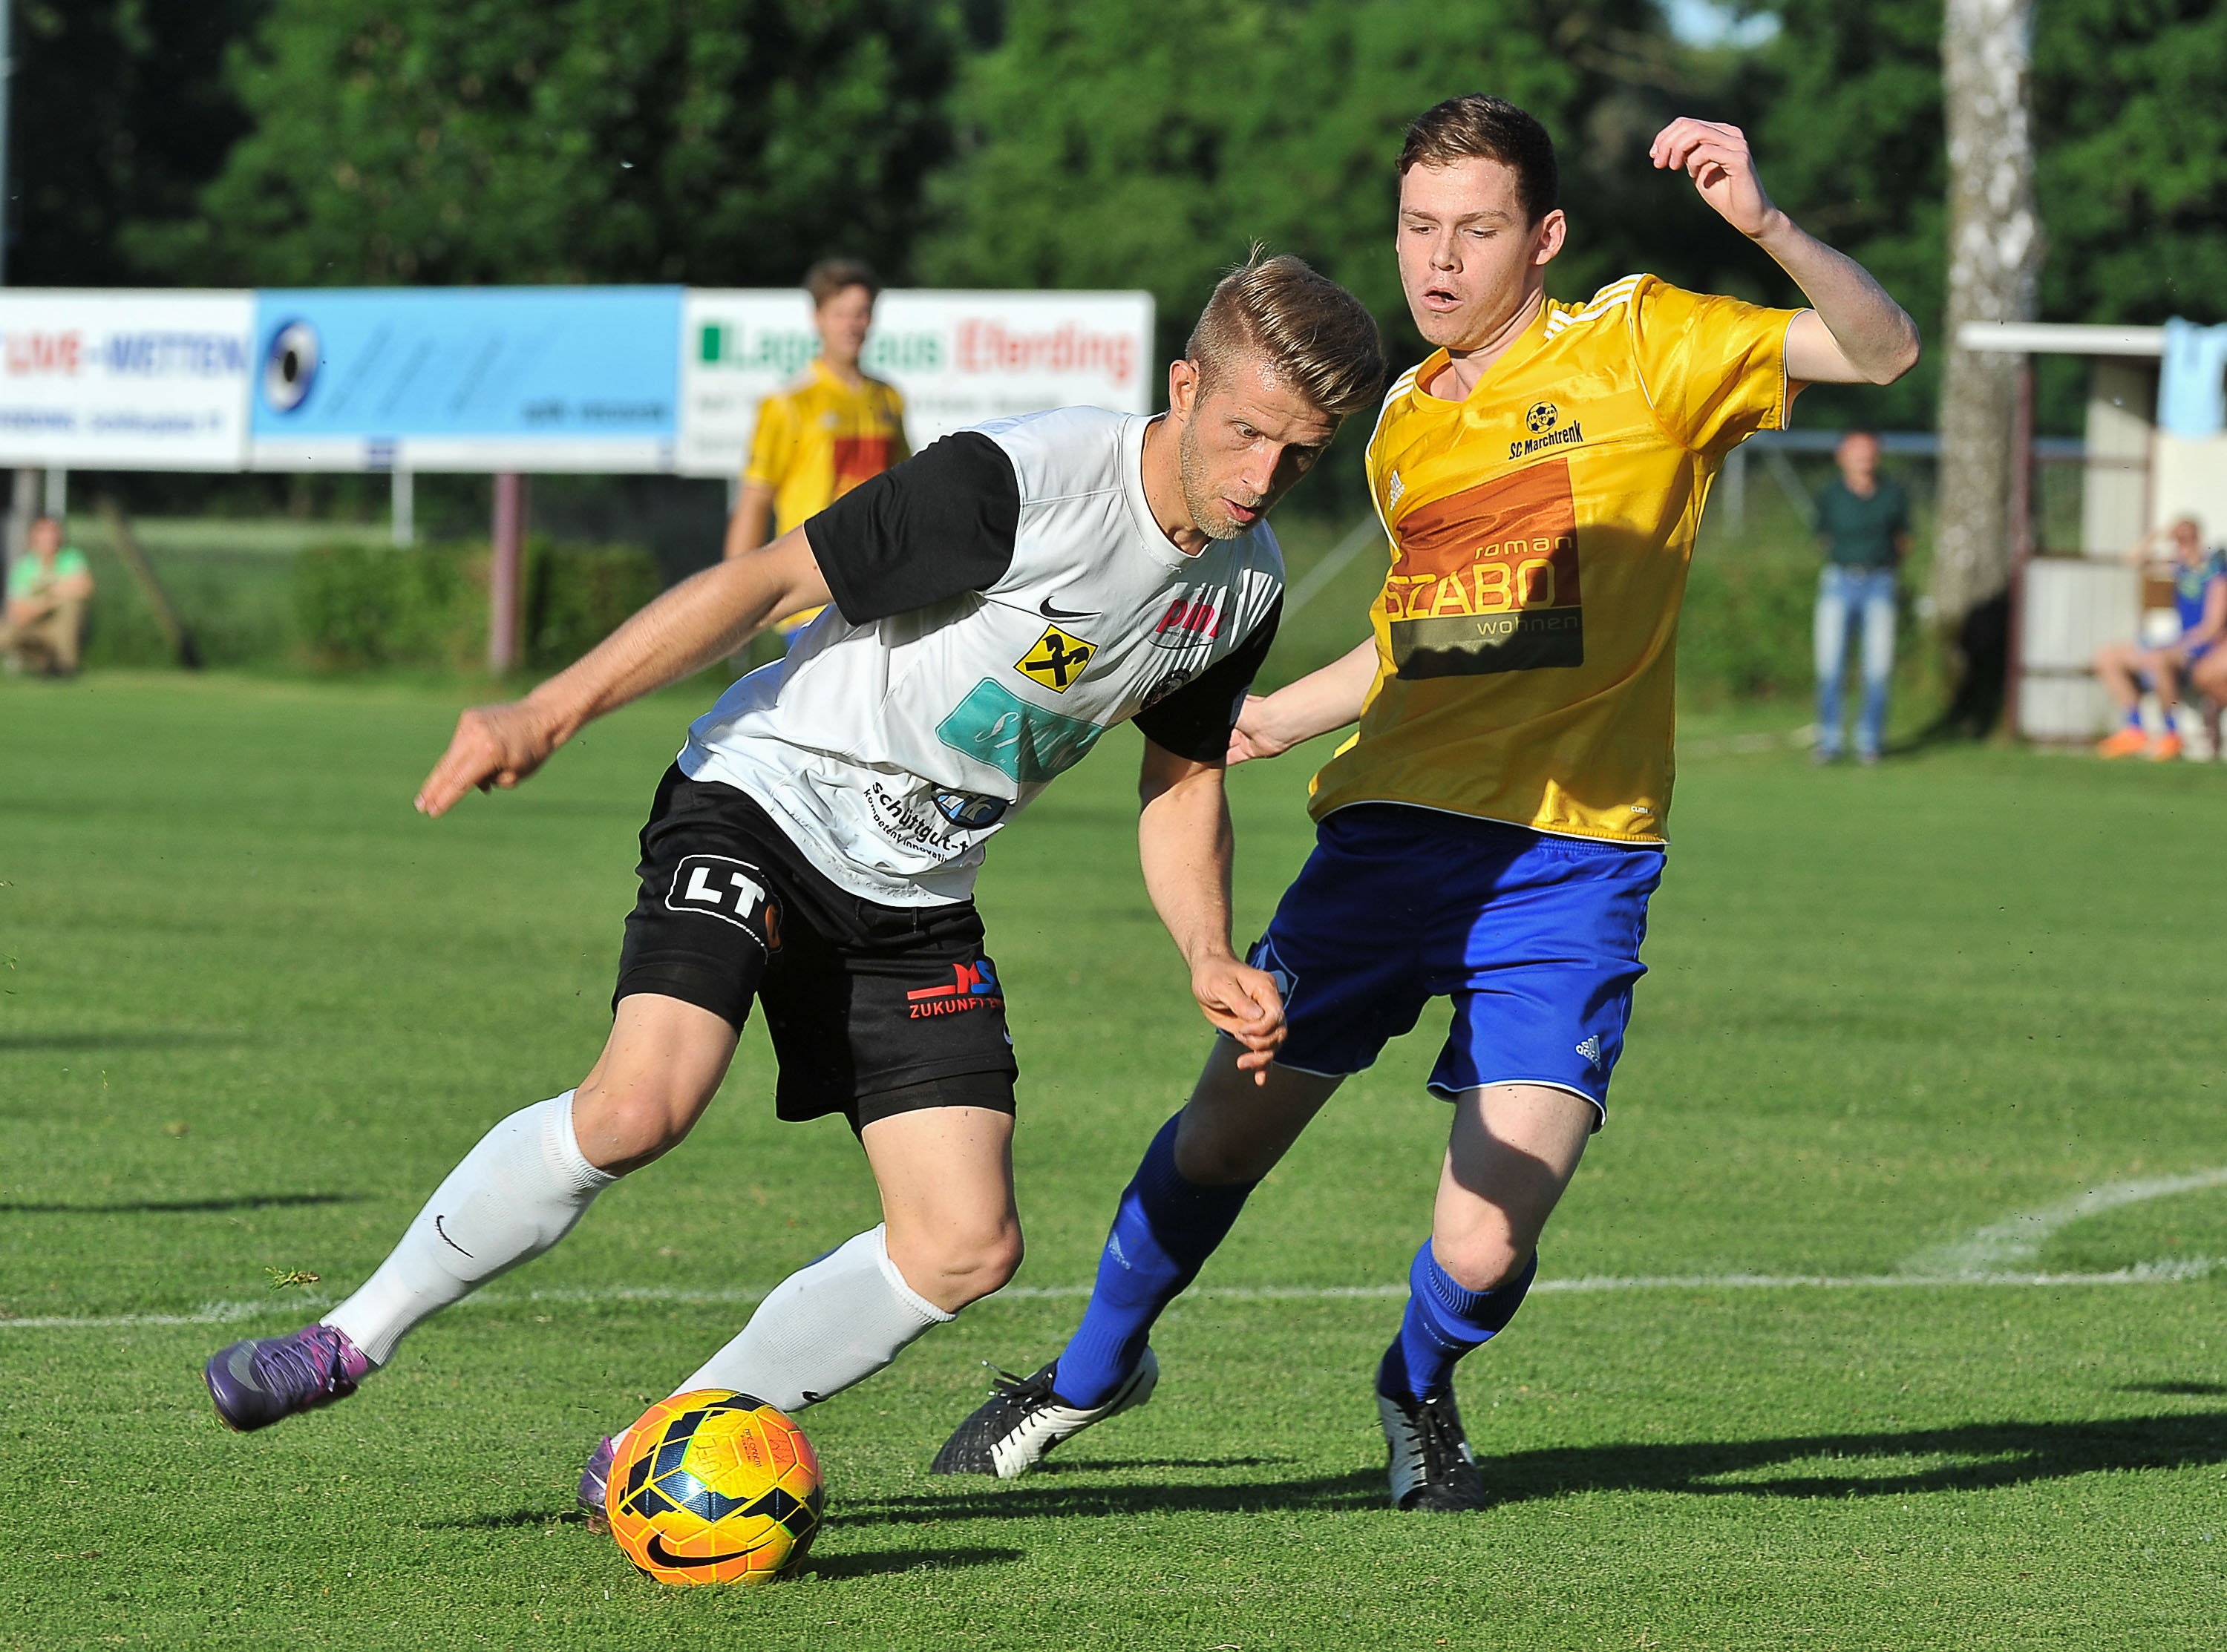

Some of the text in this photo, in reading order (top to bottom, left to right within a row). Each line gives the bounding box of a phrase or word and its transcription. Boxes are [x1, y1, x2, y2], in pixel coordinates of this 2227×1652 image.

[722, 322, 941, 380] Lageaus
[1508, 419, 1583, 459] SC Marchtrenk
[1475, 537, 1572, 560] roman
[1385, 558, 1555, 618] SZABO
[1477, 616, 1577, 636] wohnen
[684, 867, 765, 919] LT
